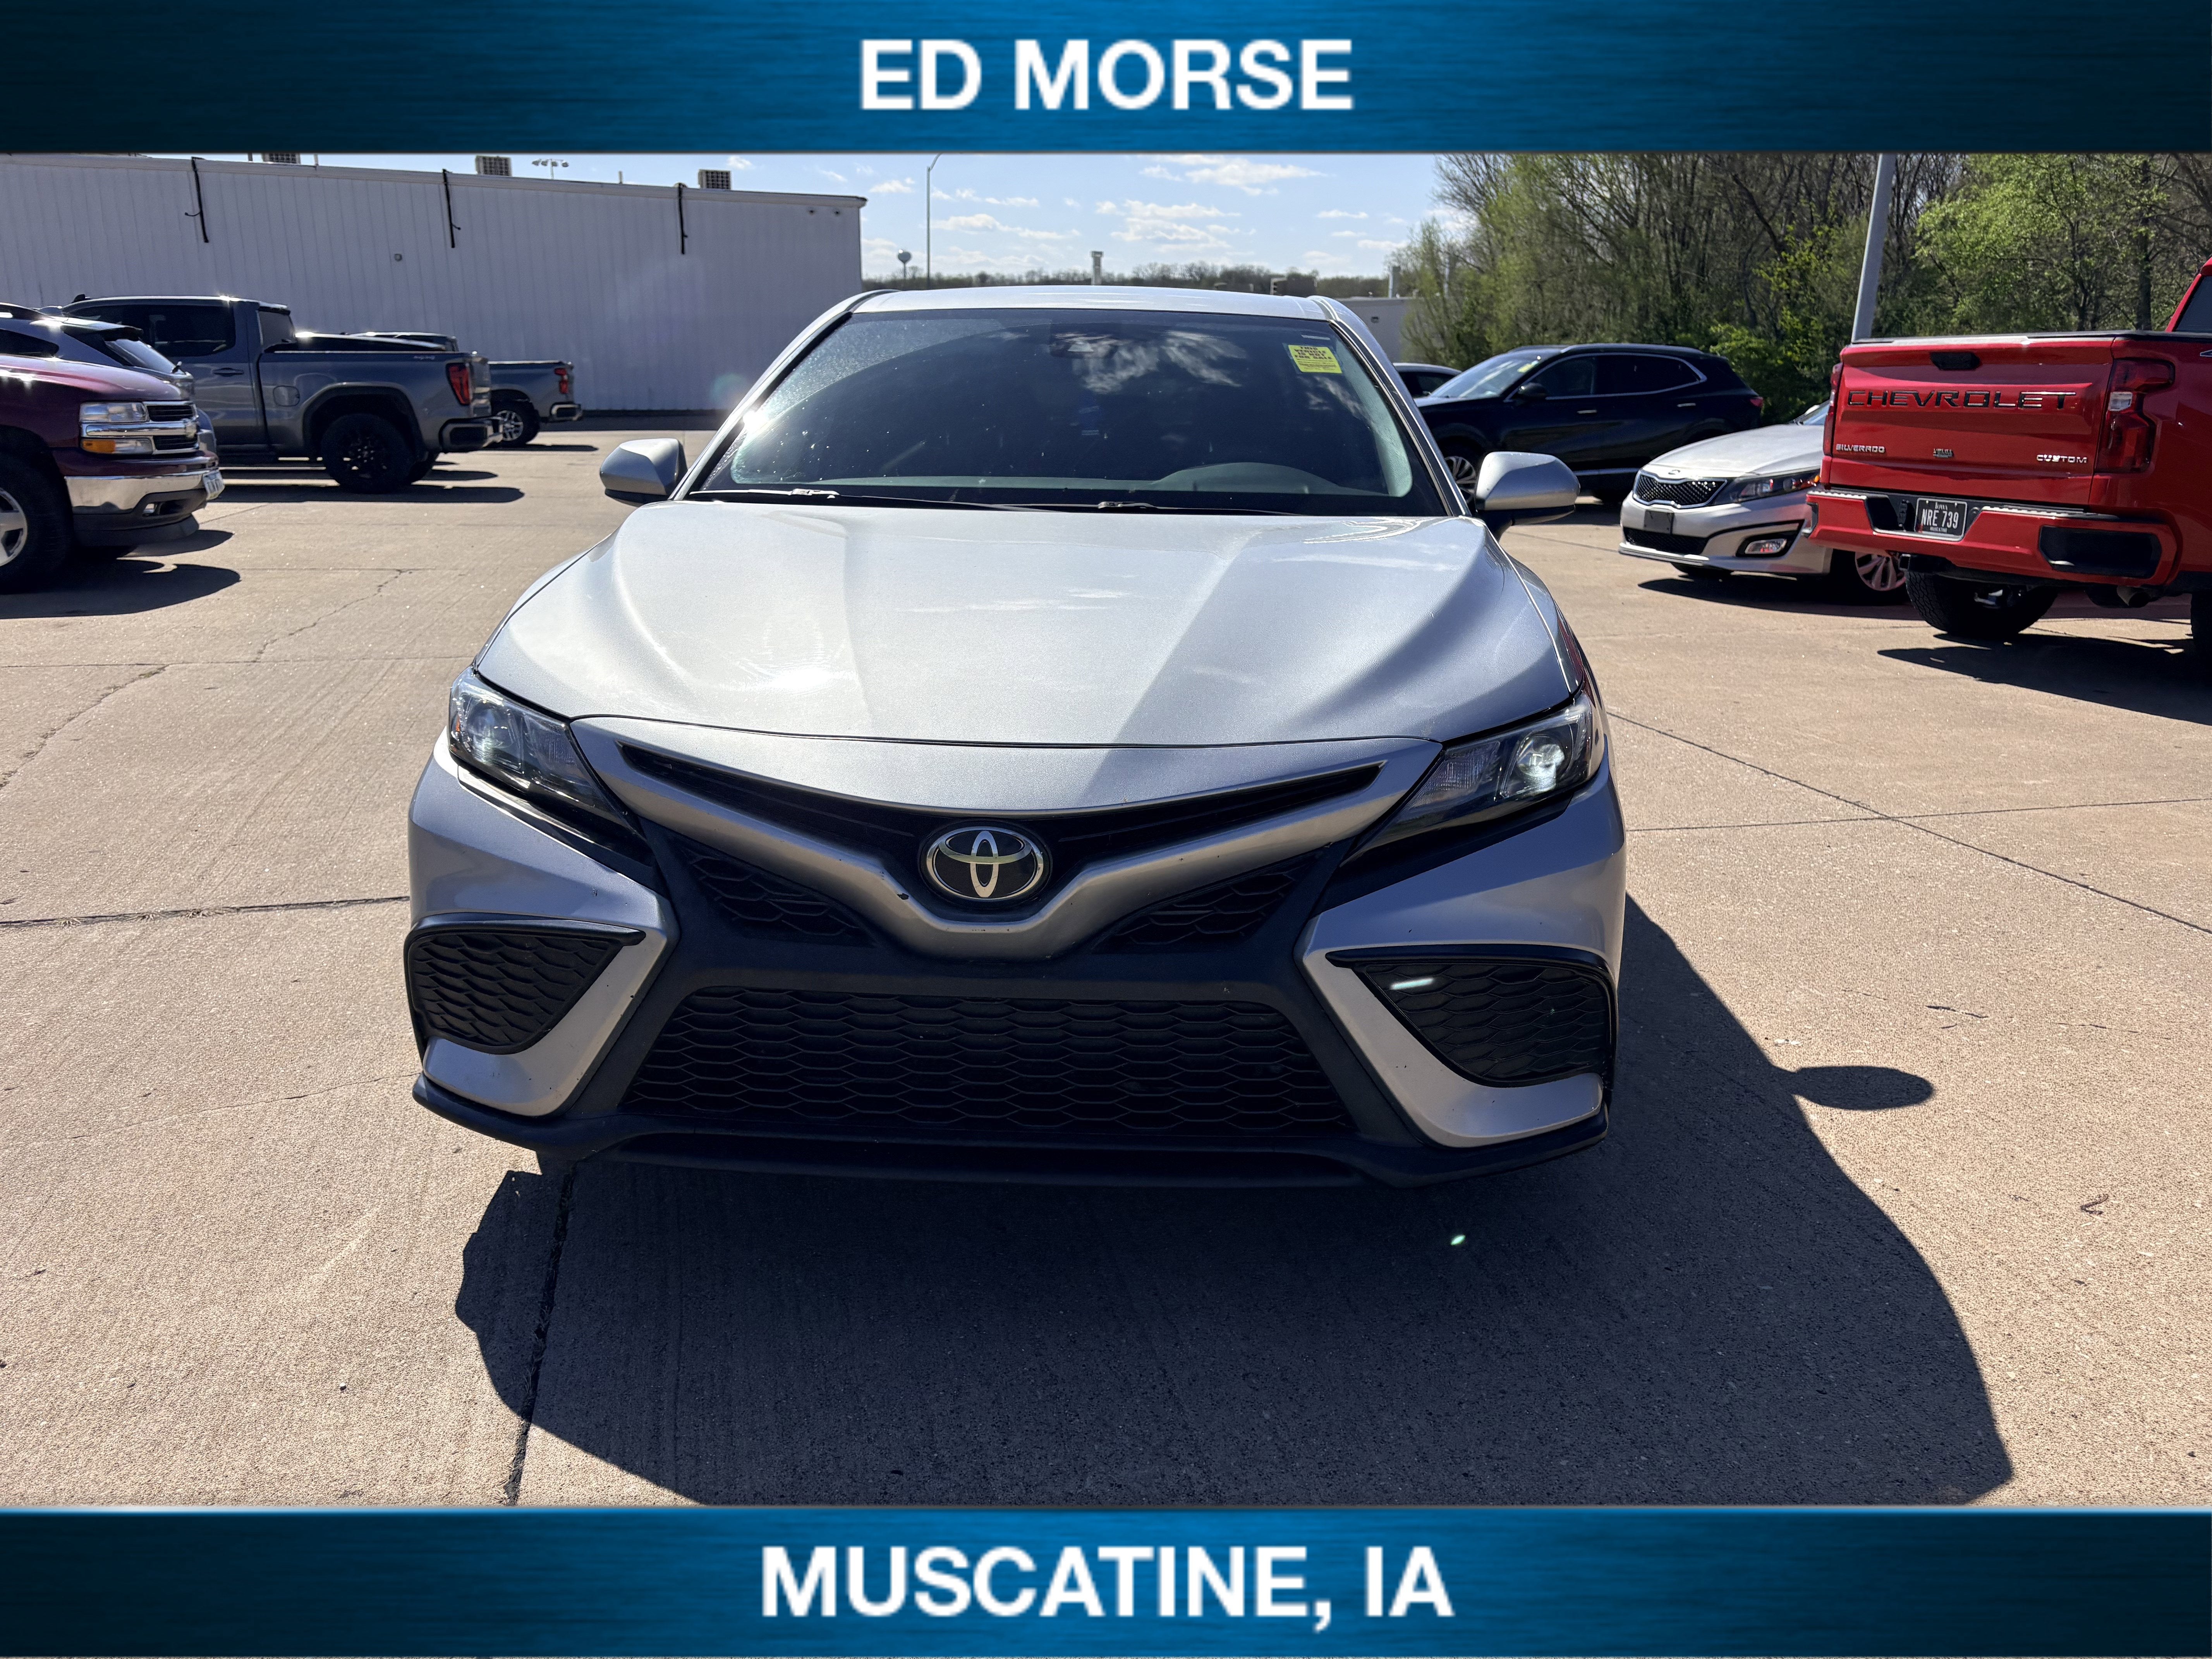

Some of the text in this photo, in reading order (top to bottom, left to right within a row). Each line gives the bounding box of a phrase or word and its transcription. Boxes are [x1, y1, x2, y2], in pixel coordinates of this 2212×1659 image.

[1847, 390, 2076, 409] CHEVROLET
[1836, 443, 1885, 453] SILVERADO
[2036, 454, 2087, 464] CUSTOM
[1921, 508, 1959, 529] NRE 739
